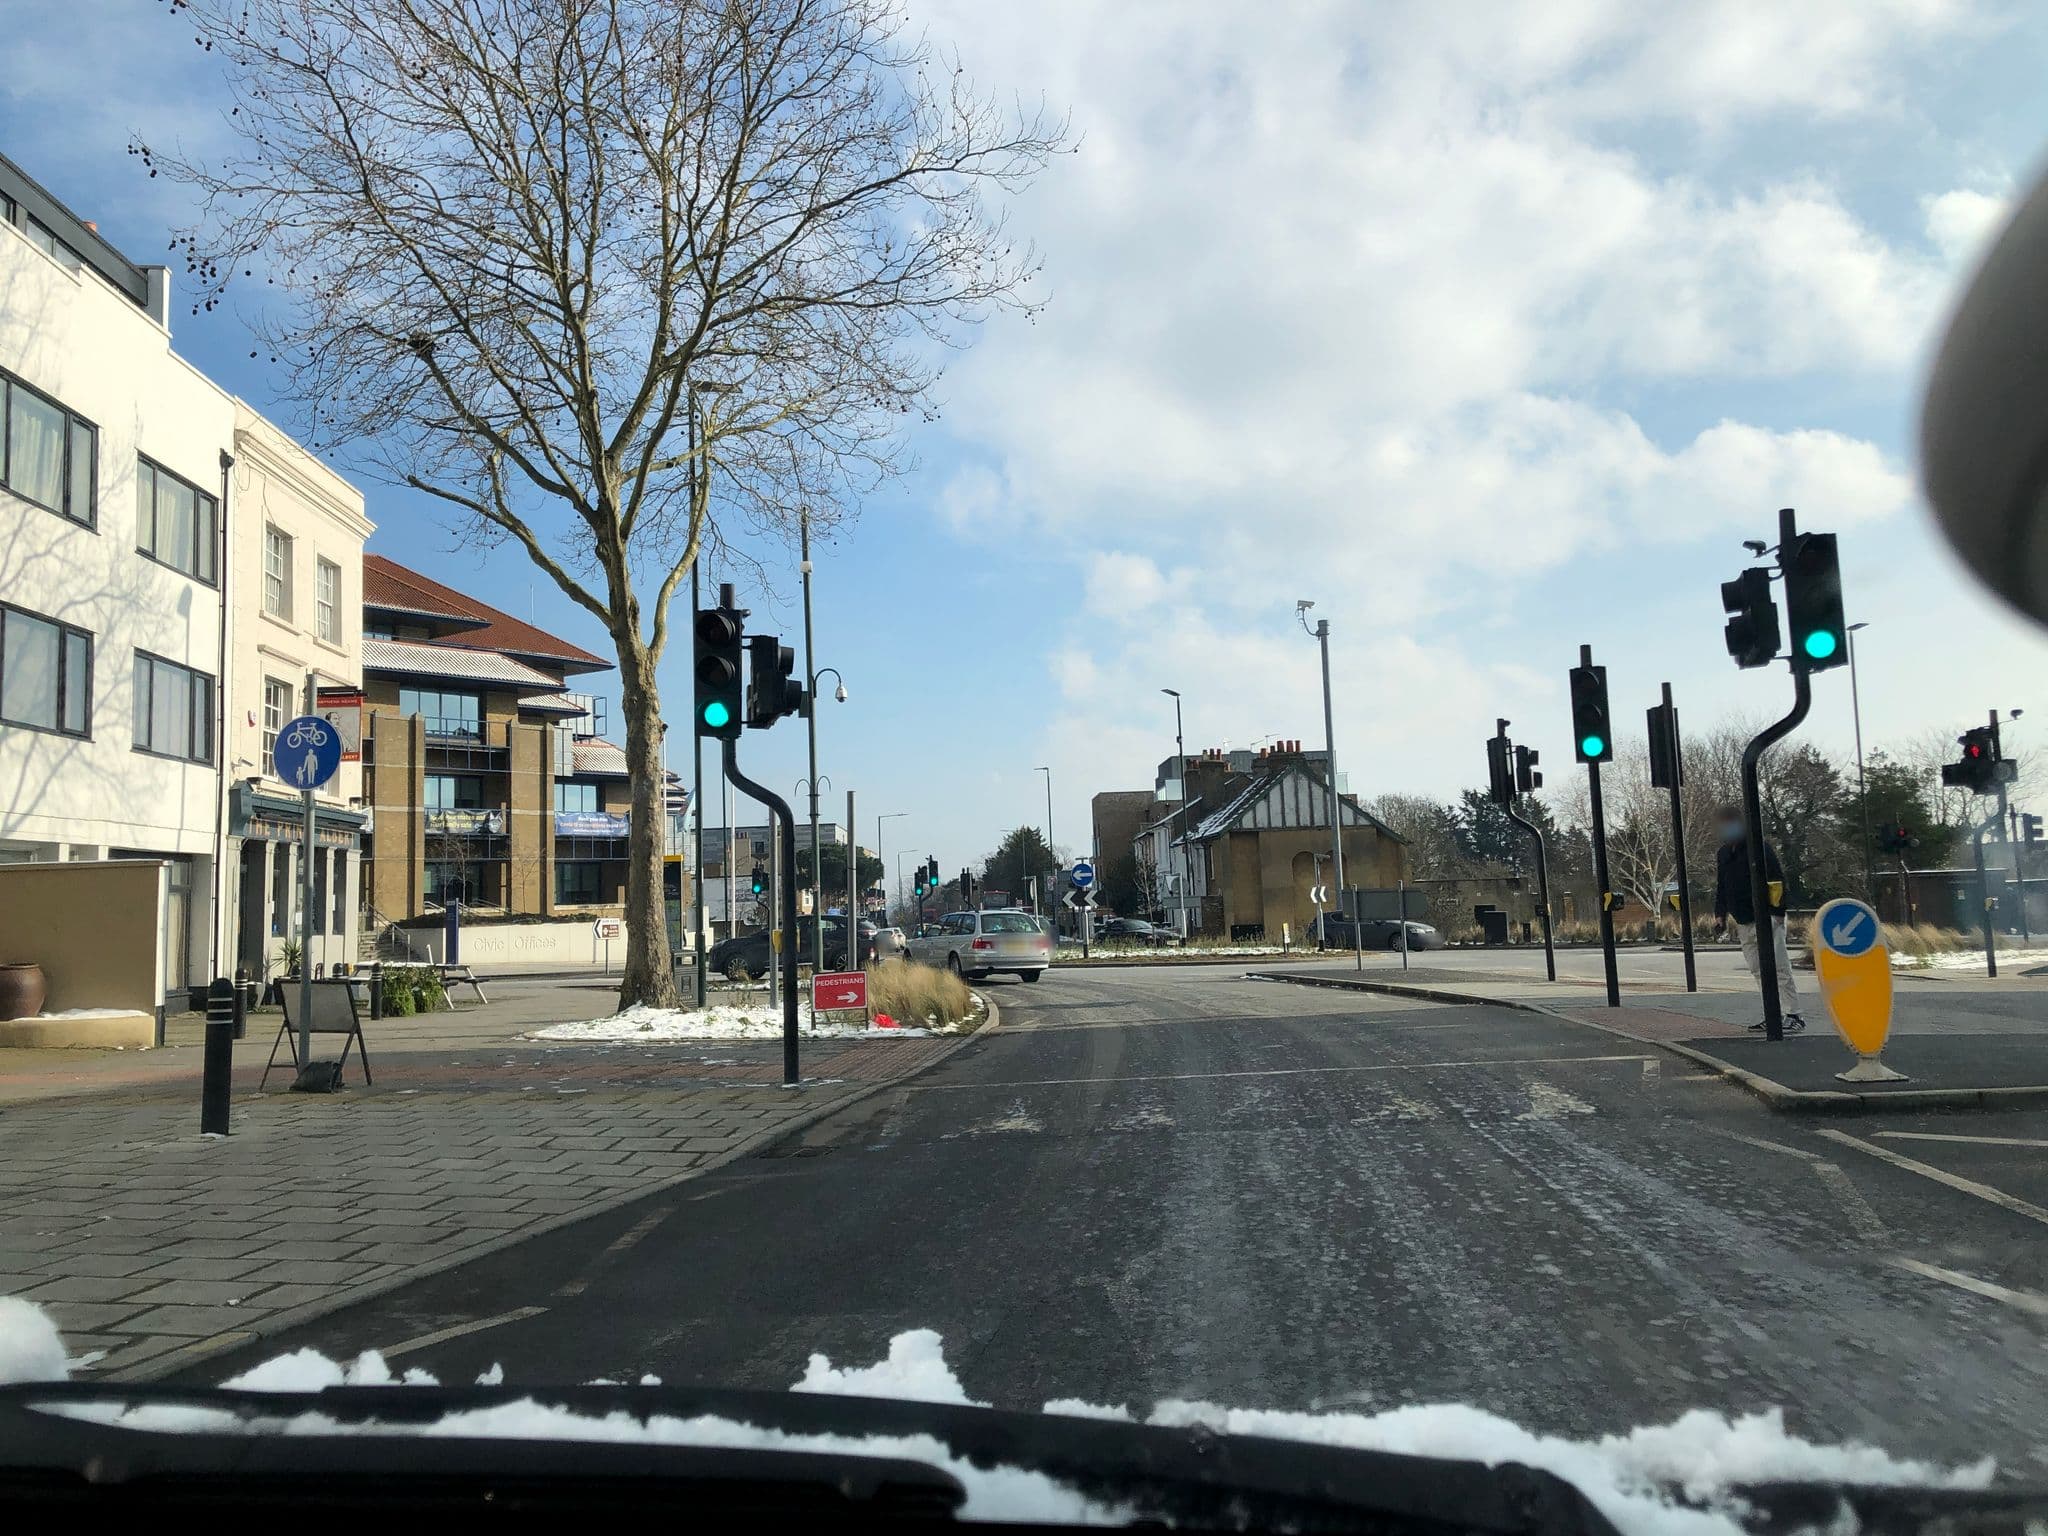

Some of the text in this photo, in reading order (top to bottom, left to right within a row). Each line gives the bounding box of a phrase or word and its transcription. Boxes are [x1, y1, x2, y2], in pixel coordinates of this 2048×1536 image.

[473, 936, 557, 951] Civic Offices
[816, 977, 865, 987] PEDESTRIANS
